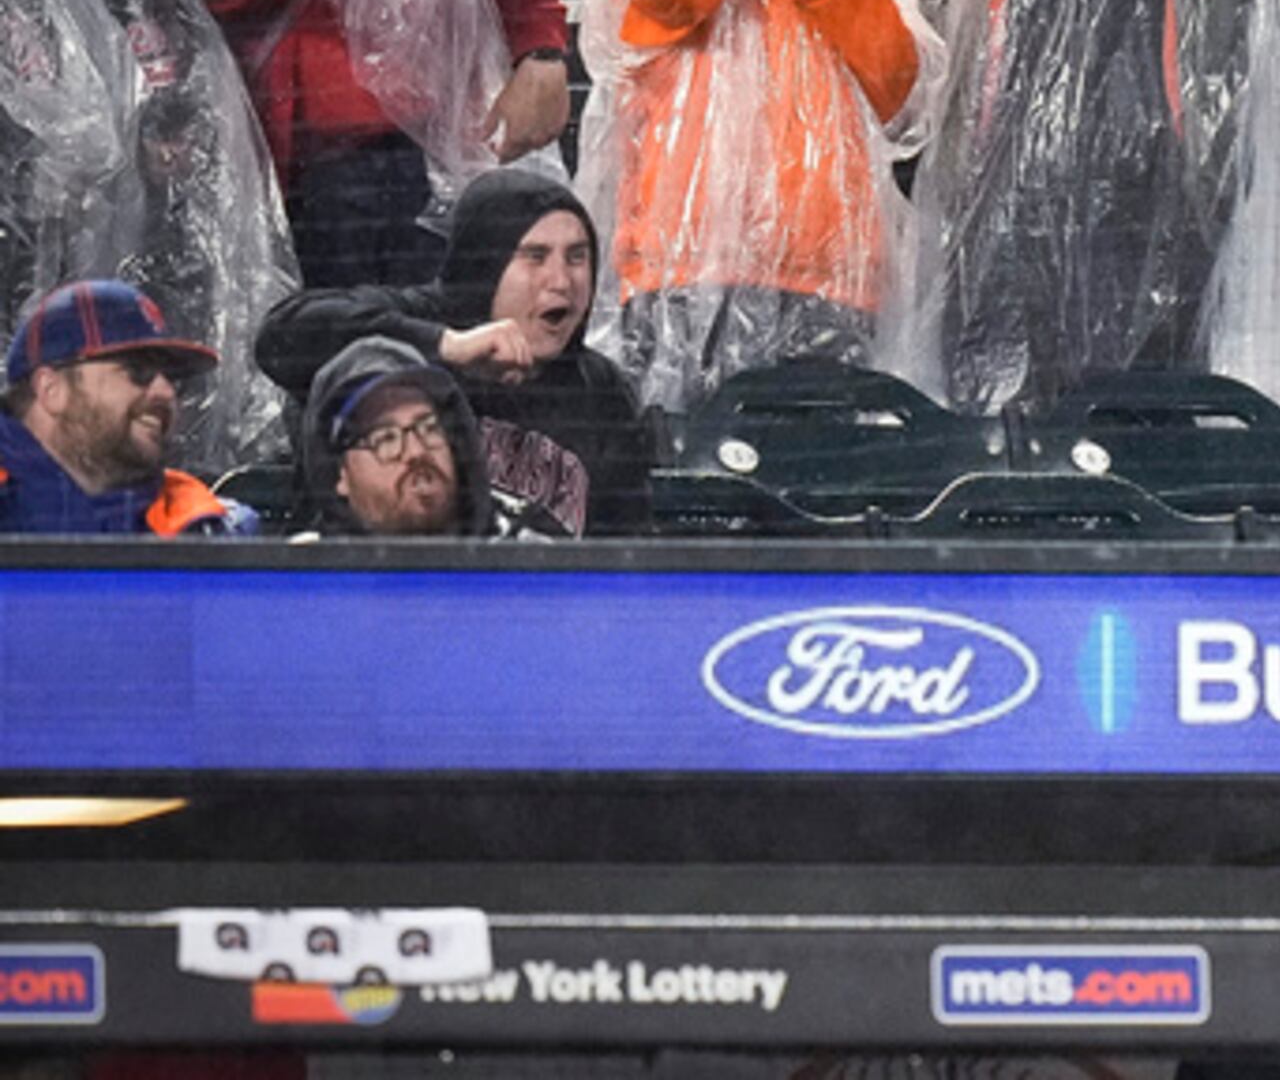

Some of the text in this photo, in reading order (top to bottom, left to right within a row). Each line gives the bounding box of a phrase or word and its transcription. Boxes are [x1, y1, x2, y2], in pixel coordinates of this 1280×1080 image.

[767, 622, 974, 715] Ford
[522, 958, 623, 1003] York
[627, 960, 788, 1011] Lottery
[950, 964, 1193, 1006] mets.com
